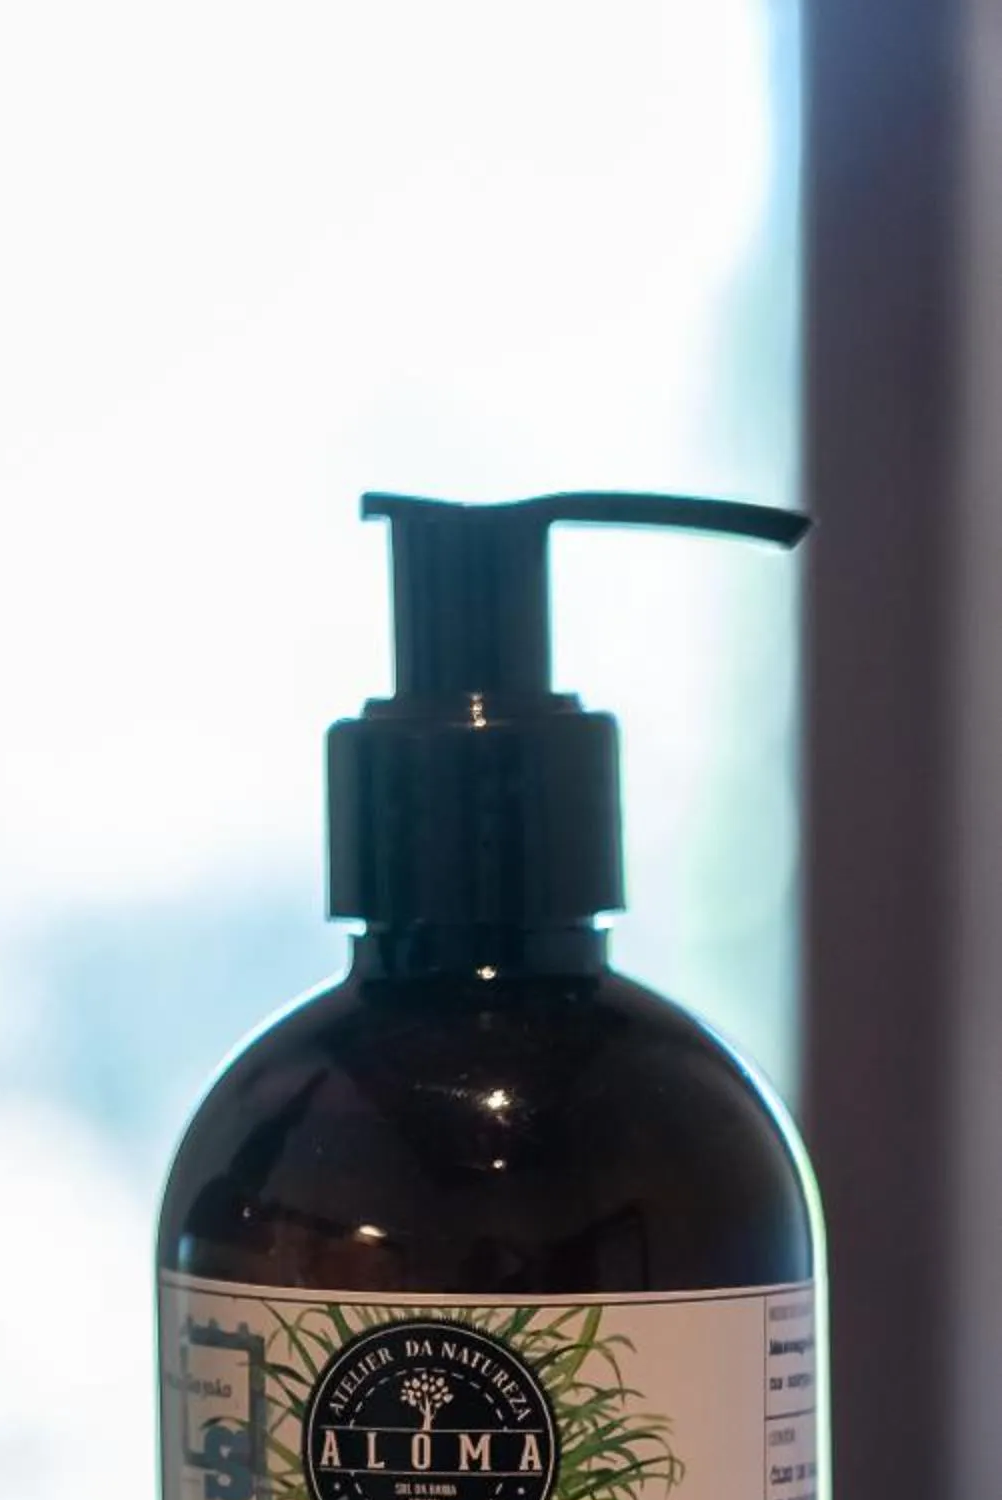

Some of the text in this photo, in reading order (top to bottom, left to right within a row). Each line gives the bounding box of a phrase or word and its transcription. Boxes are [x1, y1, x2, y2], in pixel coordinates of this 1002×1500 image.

[329, 1340, 533, 1421] ATELIER DA NATUREZA
[319, 1429, 543, 1471] ALOMA
